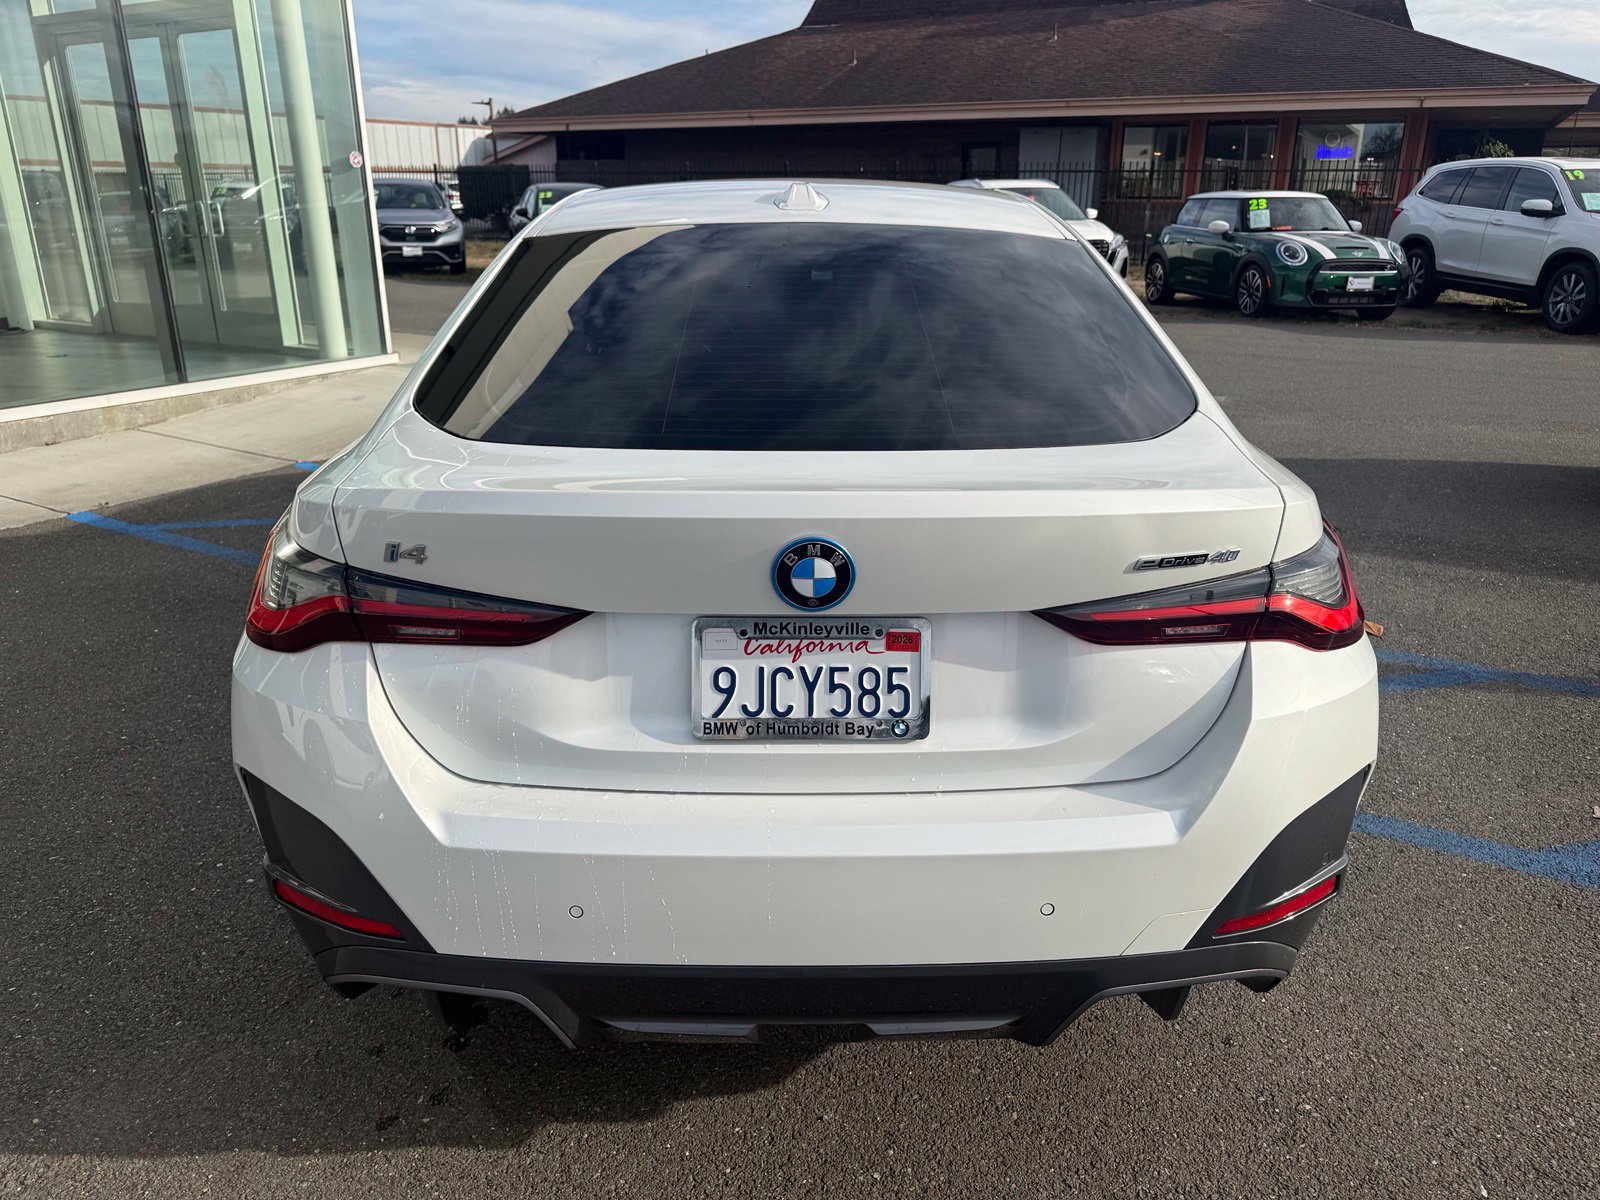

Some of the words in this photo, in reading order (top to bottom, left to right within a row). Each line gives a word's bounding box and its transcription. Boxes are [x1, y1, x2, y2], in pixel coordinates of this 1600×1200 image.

[1564, 169, 1585, 181] 19
[1248, 198, 1267, 210] 23
[383, 542, 428, 565] i4
[783, 544, 846, 567] BMW
[753, 621, 870, 638] McKinleyville
[891, 635, 914, 645] 2026
[743, 637, 885, 663] California
[711, 666, 912, 718] 9JCY585
[703, 723, 738, 735] BMW
[746, 723, 760, 735] of
[766, 722, 839, 735] Humboldt
[845, 723, 874, 738] Bay
